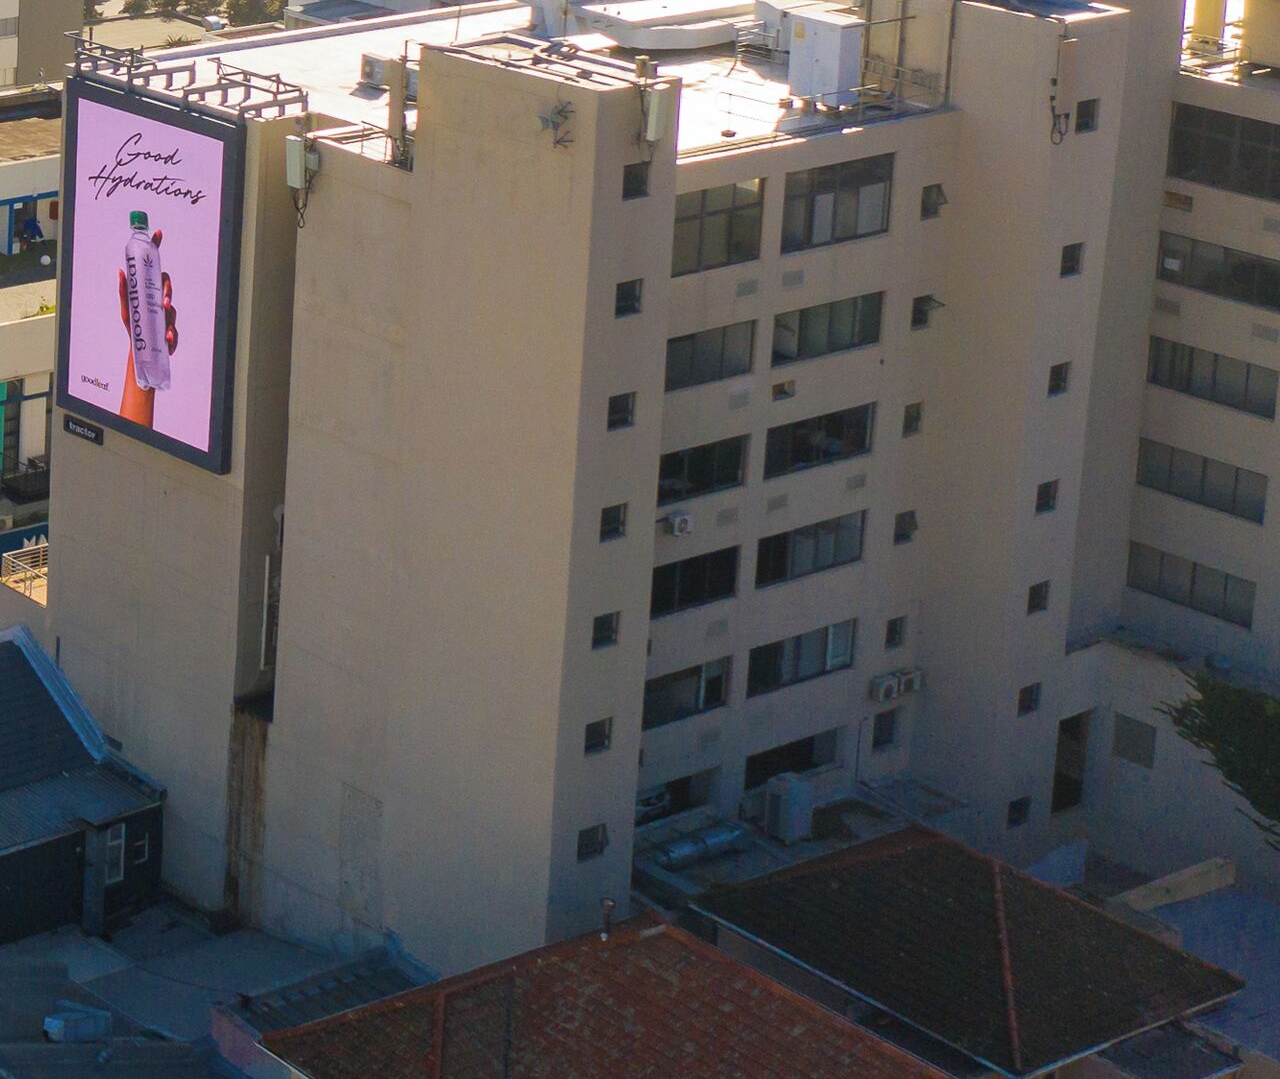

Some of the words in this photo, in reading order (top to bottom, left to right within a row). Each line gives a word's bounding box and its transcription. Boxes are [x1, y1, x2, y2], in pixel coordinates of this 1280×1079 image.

[115, 132, 183, 167] Good
[88, 158, 207, 205] Hydrations
[69, 421, 96, 439] tractor
